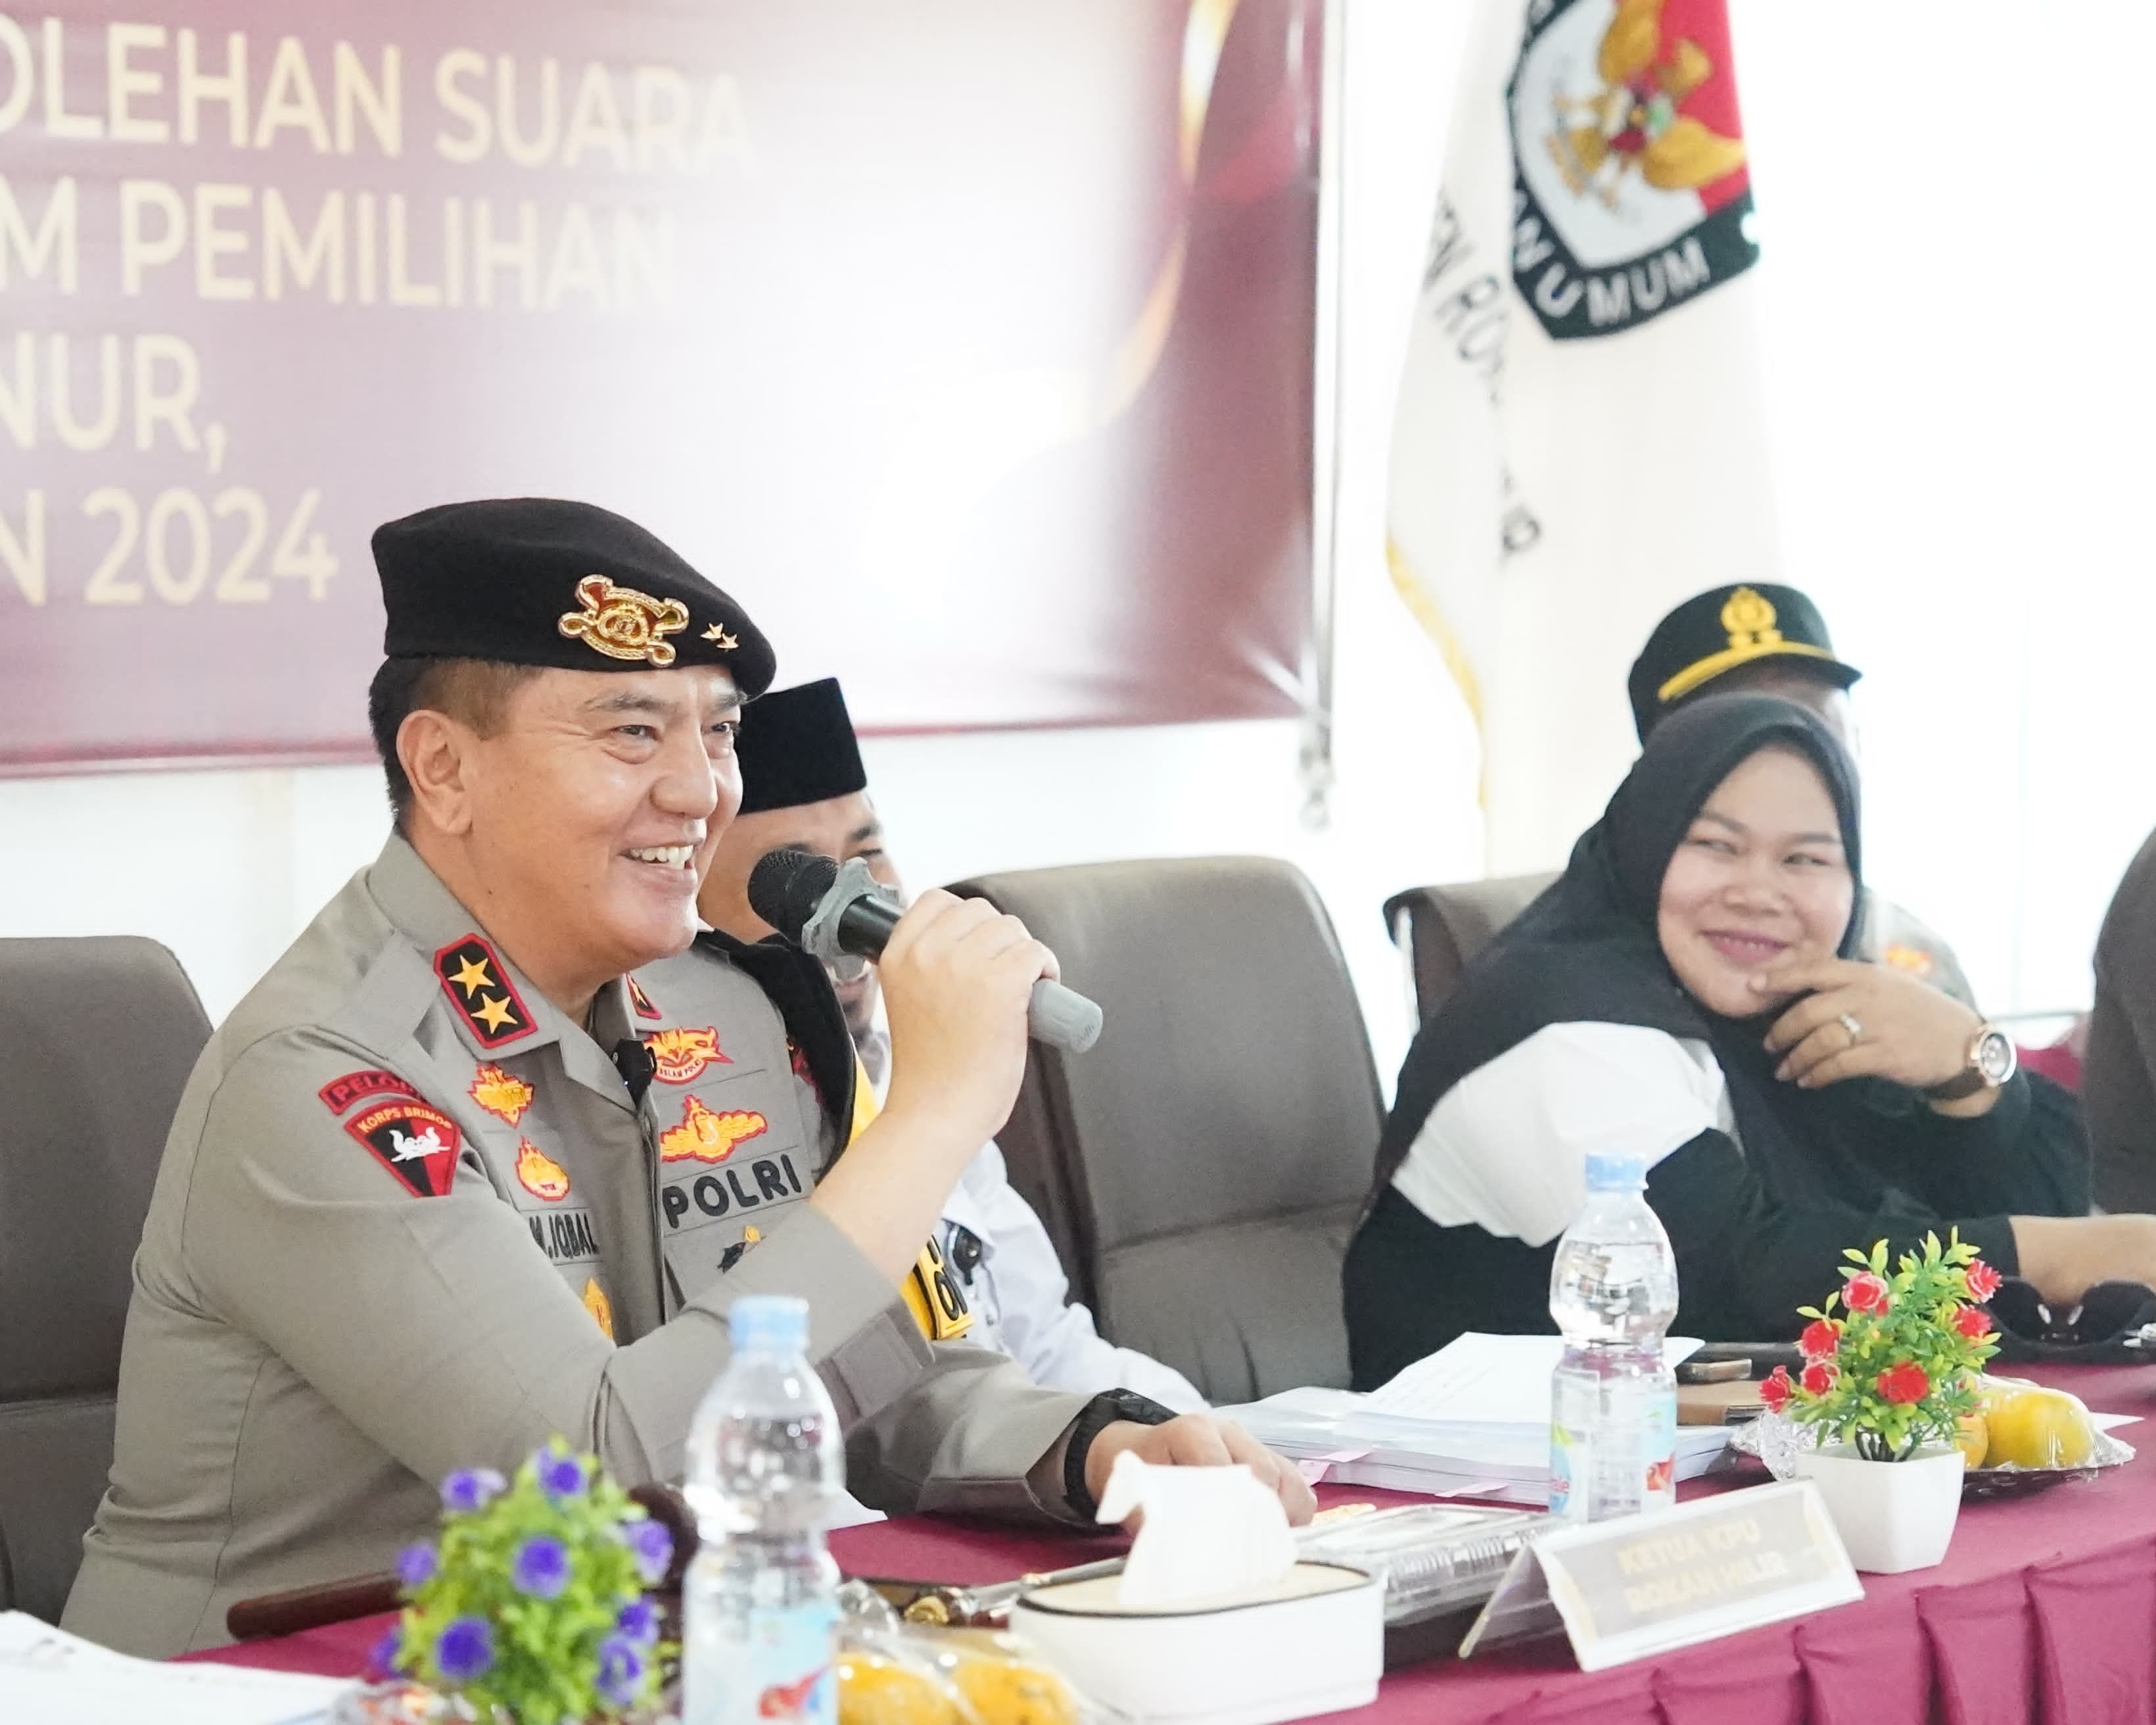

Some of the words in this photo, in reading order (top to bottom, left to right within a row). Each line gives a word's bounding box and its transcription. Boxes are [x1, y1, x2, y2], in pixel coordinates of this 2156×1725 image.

[434, 49, 761, 178] SUARA
[120, 179, 678, 312] PEMILIHAN
[1535, 236, 1710, 327] UMUM
[83, 488, 339, 604] 2024
[357, 1108, 401, 1133] KORPS
[404, 1106, 453, 1129] BRIMOB
[662, 1154, 802, 1229] POLRI
